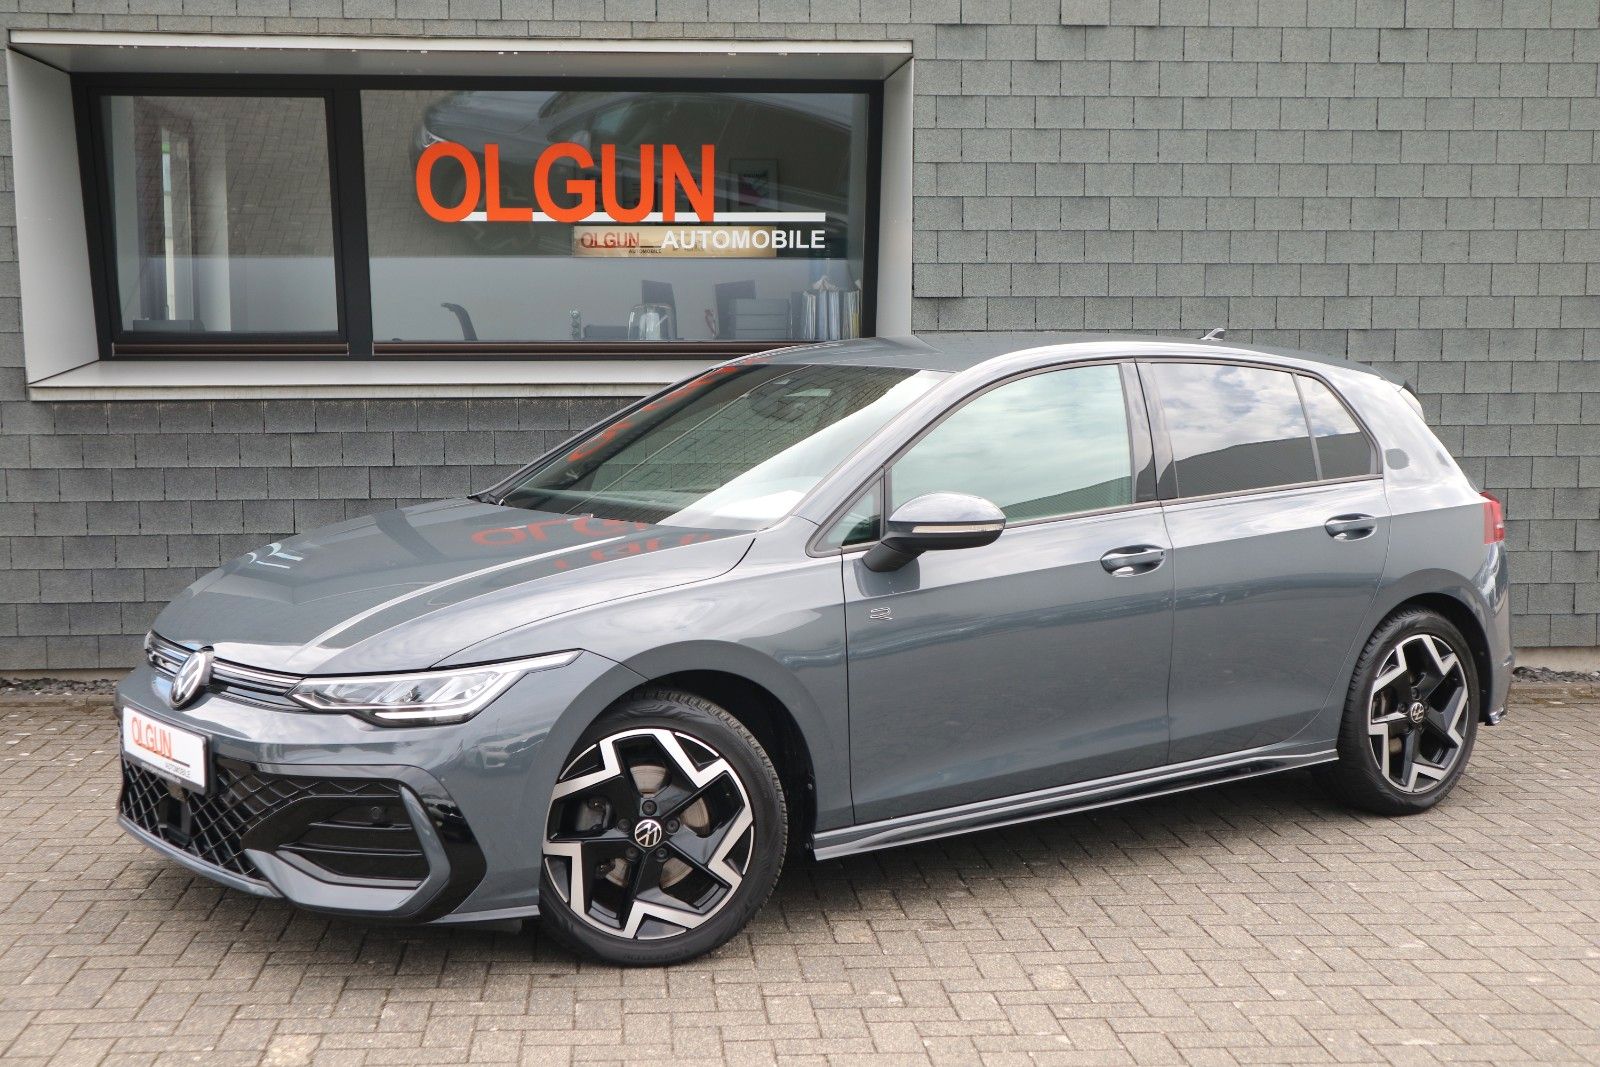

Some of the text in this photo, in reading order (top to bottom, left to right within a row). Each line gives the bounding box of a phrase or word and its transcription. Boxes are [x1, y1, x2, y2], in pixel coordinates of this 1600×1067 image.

[415, 141, 715, 222] OLGUN
[581, 232, 640, 248] OLGUN
[661, 230, 825, 249] AUTOMOBILE
[131, 717, 172, 759] OLGUN
